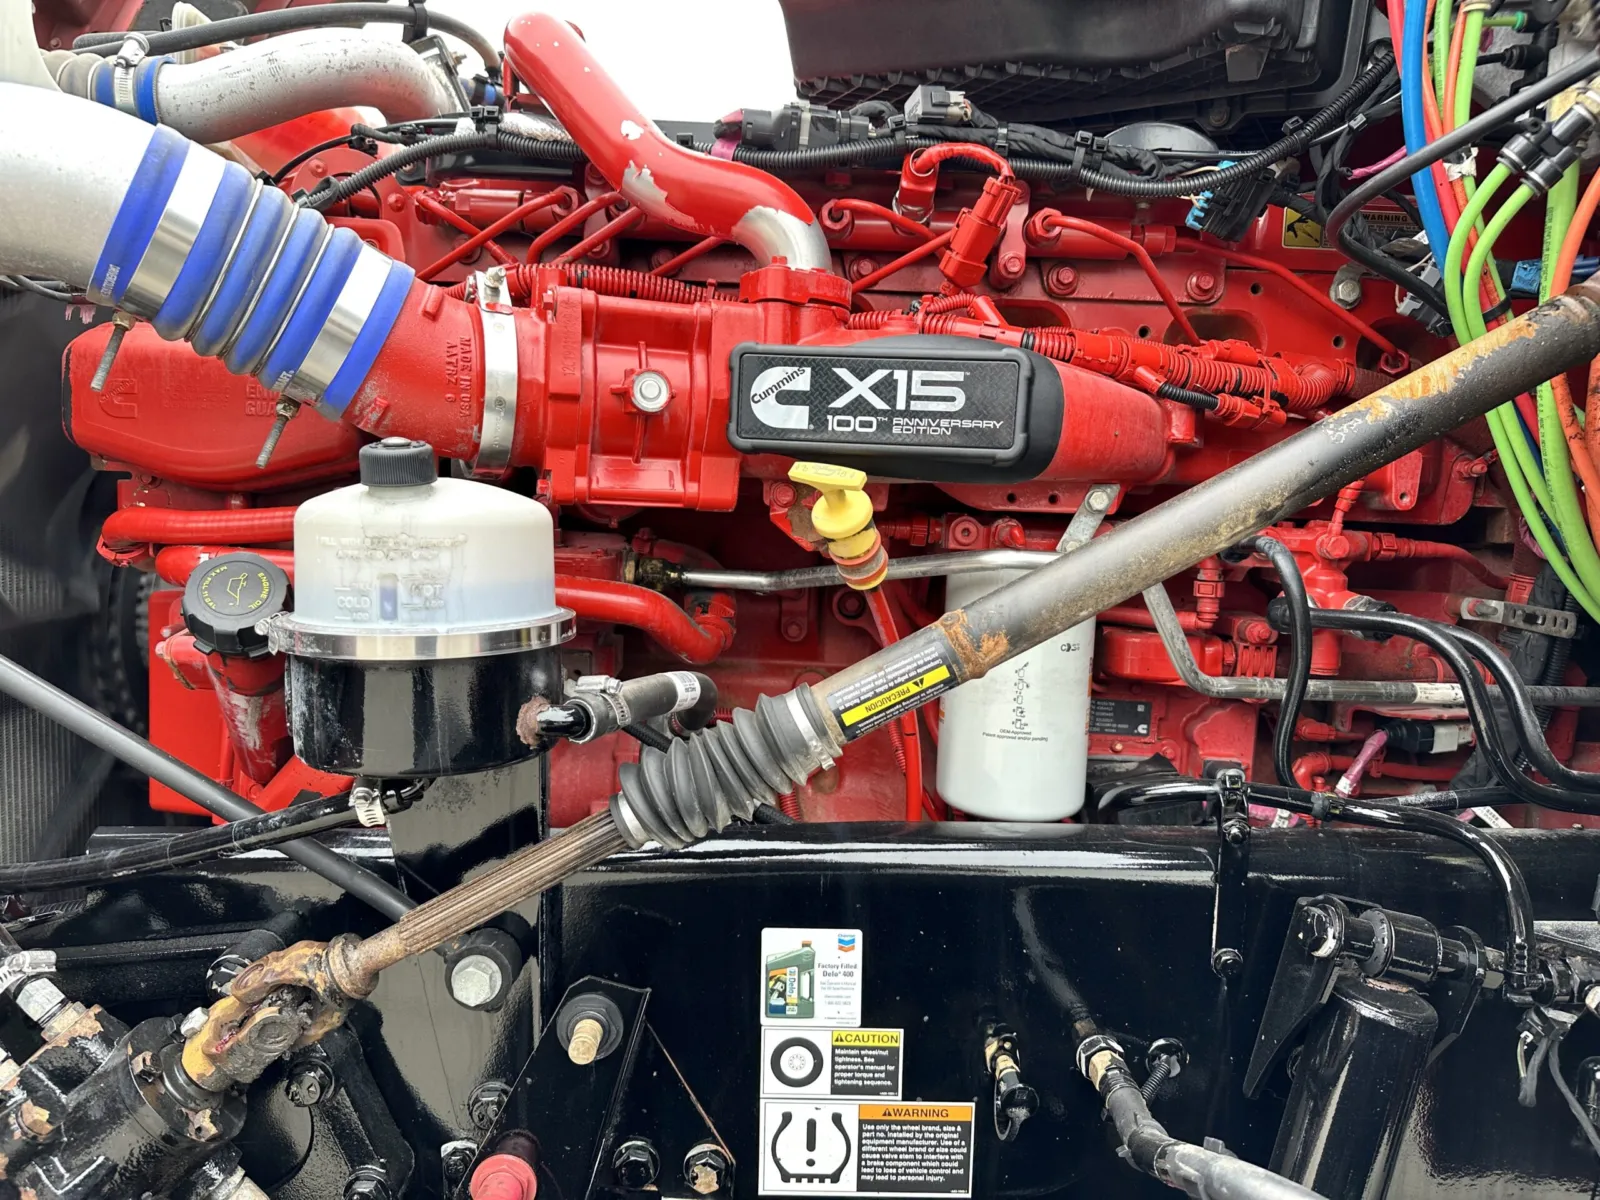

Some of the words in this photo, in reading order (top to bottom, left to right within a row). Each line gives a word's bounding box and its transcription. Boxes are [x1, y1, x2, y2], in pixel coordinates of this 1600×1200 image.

[1362, 213, 1407, 222] WARNING
[460, 337, 471, 371] MADE
[460, 376, 471, 390] IN
[751, 366, 806, 405] Cummins
[460, 393, 471, 418] USA
[892, 418, 1004, 429] ANNIVERSARY
[892, 426, 952, 436] EDITION
[211, 566, 227, 576] MAX
[202, 577, 212, 589] FILL
[257, 572, 271, 599] ENGINE
[248, 601, 262, 609] OIL
[337, 596, 371, 608] COLD
[863, 685, 910, 713] PRECAUCION
[845, 1034, 898, 1043] CAUTION
[893, 1109, 949, 1118] WARNING
